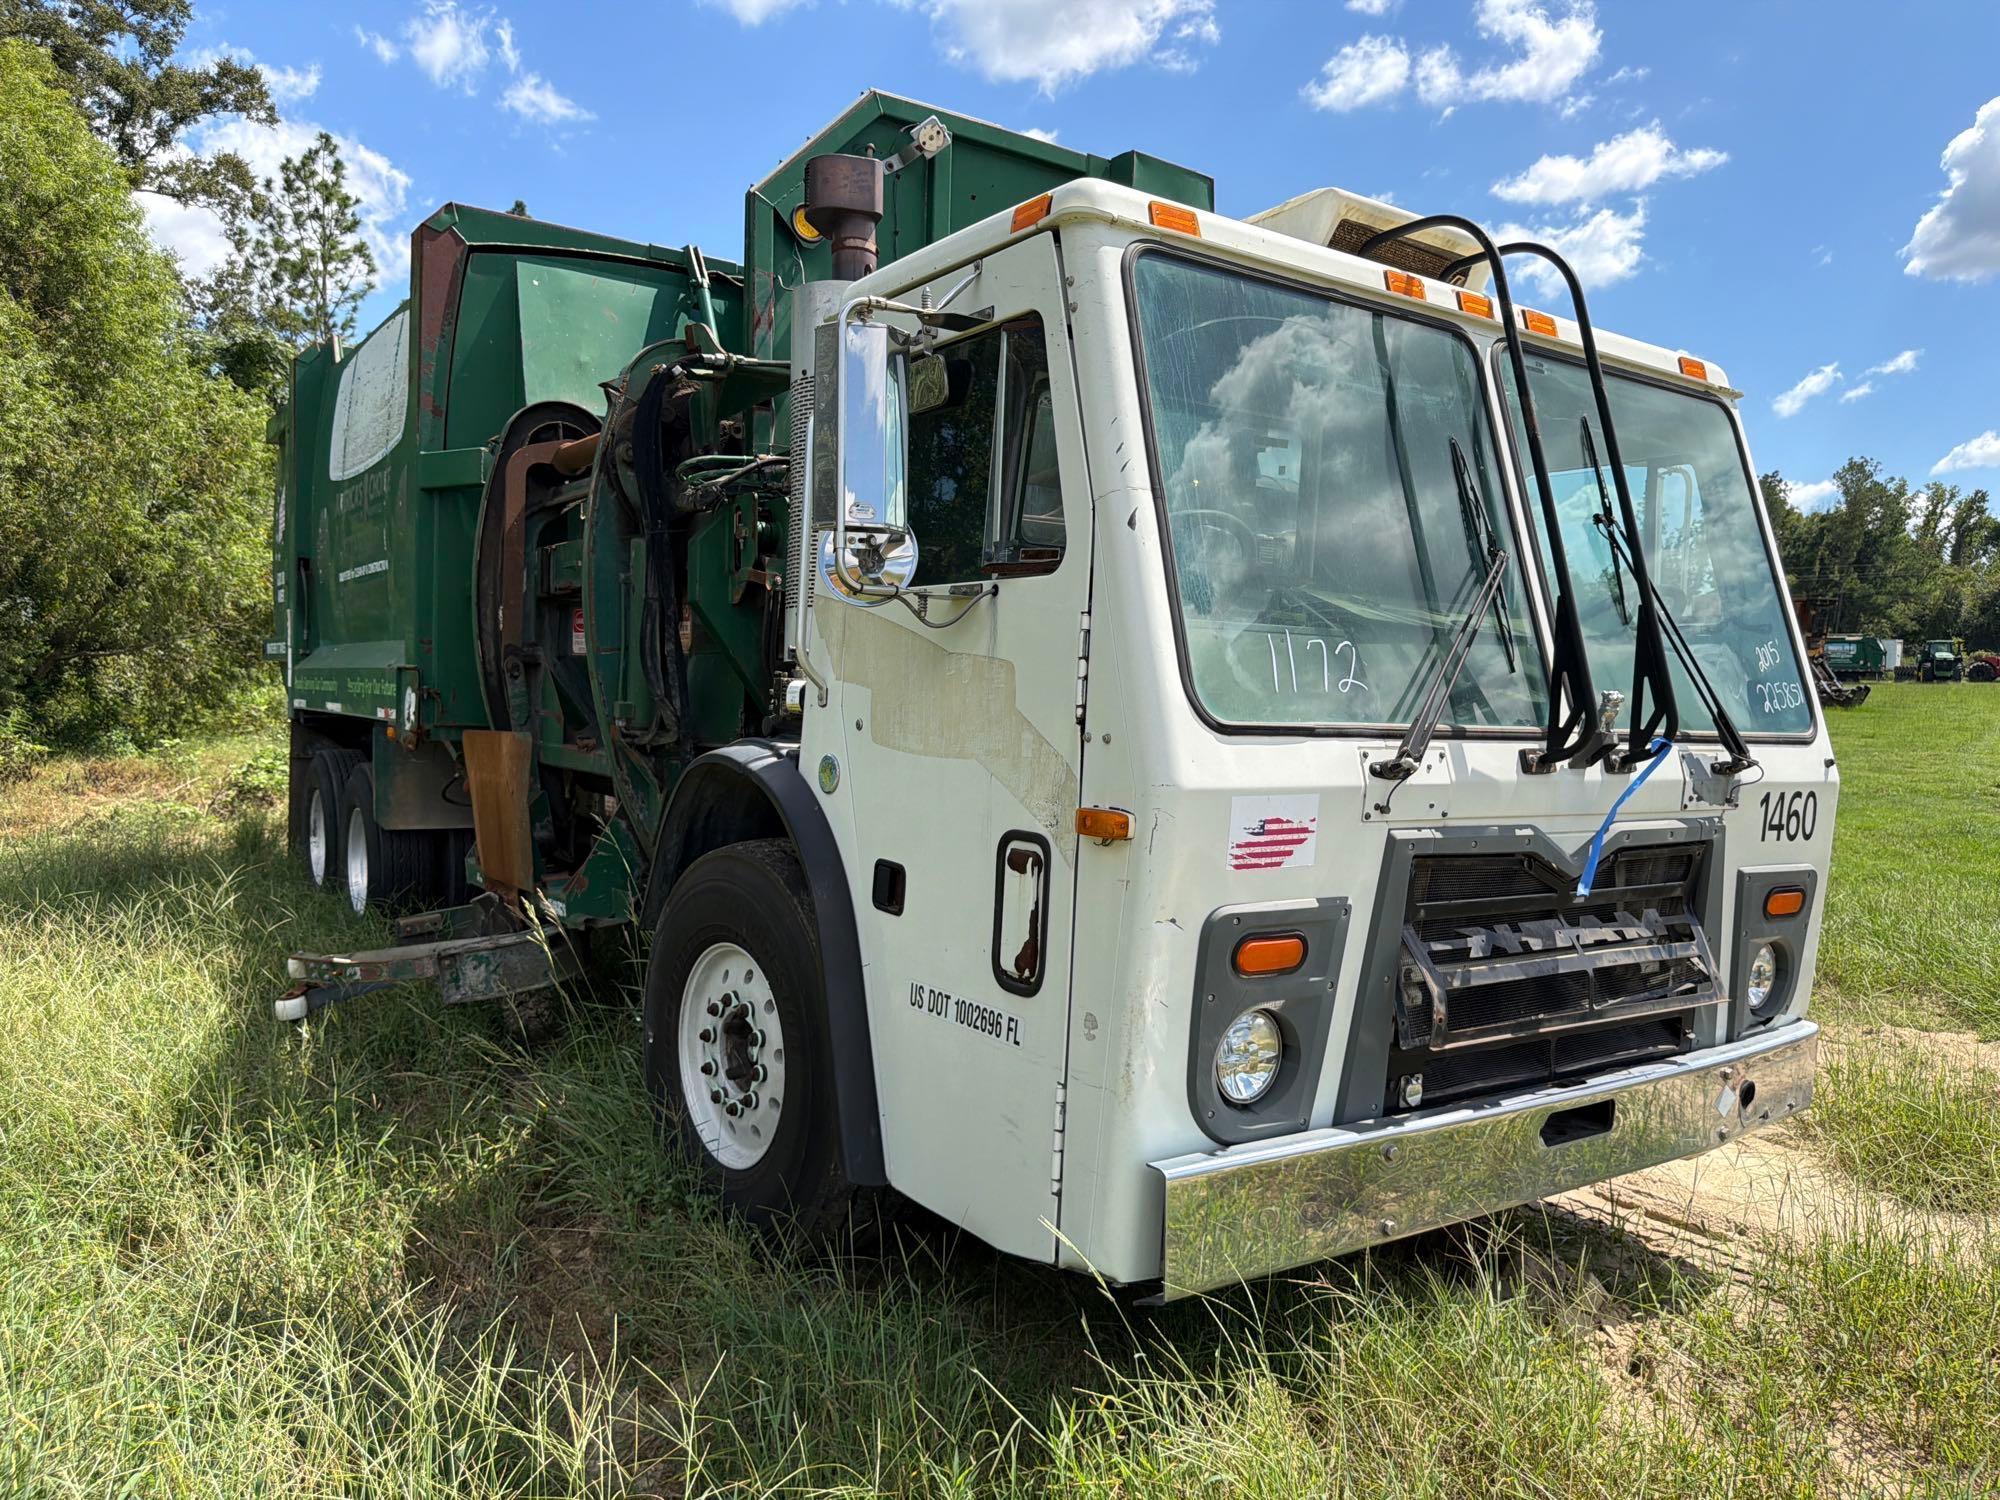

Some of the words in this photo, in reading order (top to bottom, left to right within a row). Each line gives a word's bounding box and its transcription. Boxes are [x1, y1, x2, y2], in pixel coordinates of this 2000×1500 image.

[1267, 629, 1369, 693] 1172
[1760, 791, 1818, 842] 1460
[910, 982, 924, 1010] US
[928, 989, 951, 1018] DOT
[955, 998, 1003, 1039] 1002696
[1006, 1016, 1020, 1046] FL
